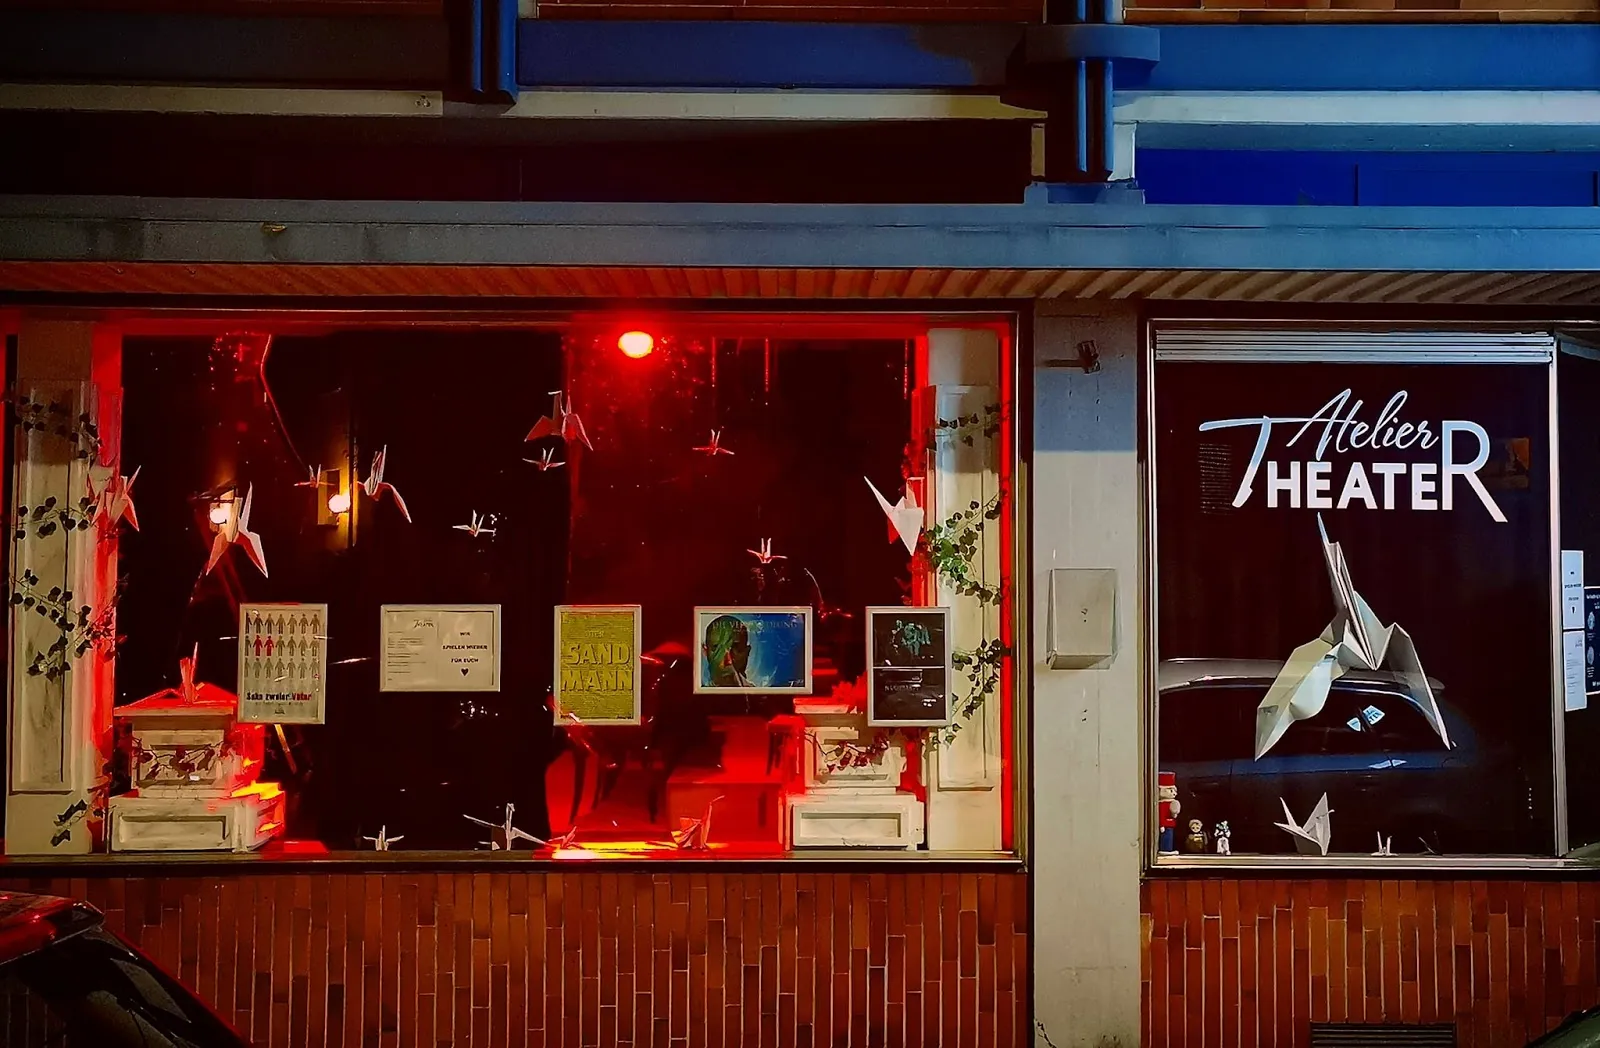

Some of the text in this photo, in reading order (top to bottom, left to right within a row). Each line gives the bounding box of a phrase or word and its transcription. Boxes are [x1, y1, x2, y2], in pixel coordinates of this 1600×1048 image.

[1286, 388, 1440, 462] Atelier
[1199, 415, 1508, 522] THEATER
[563, 643, 631, 666] SAND
[560, 668, 634, 692] MANN
